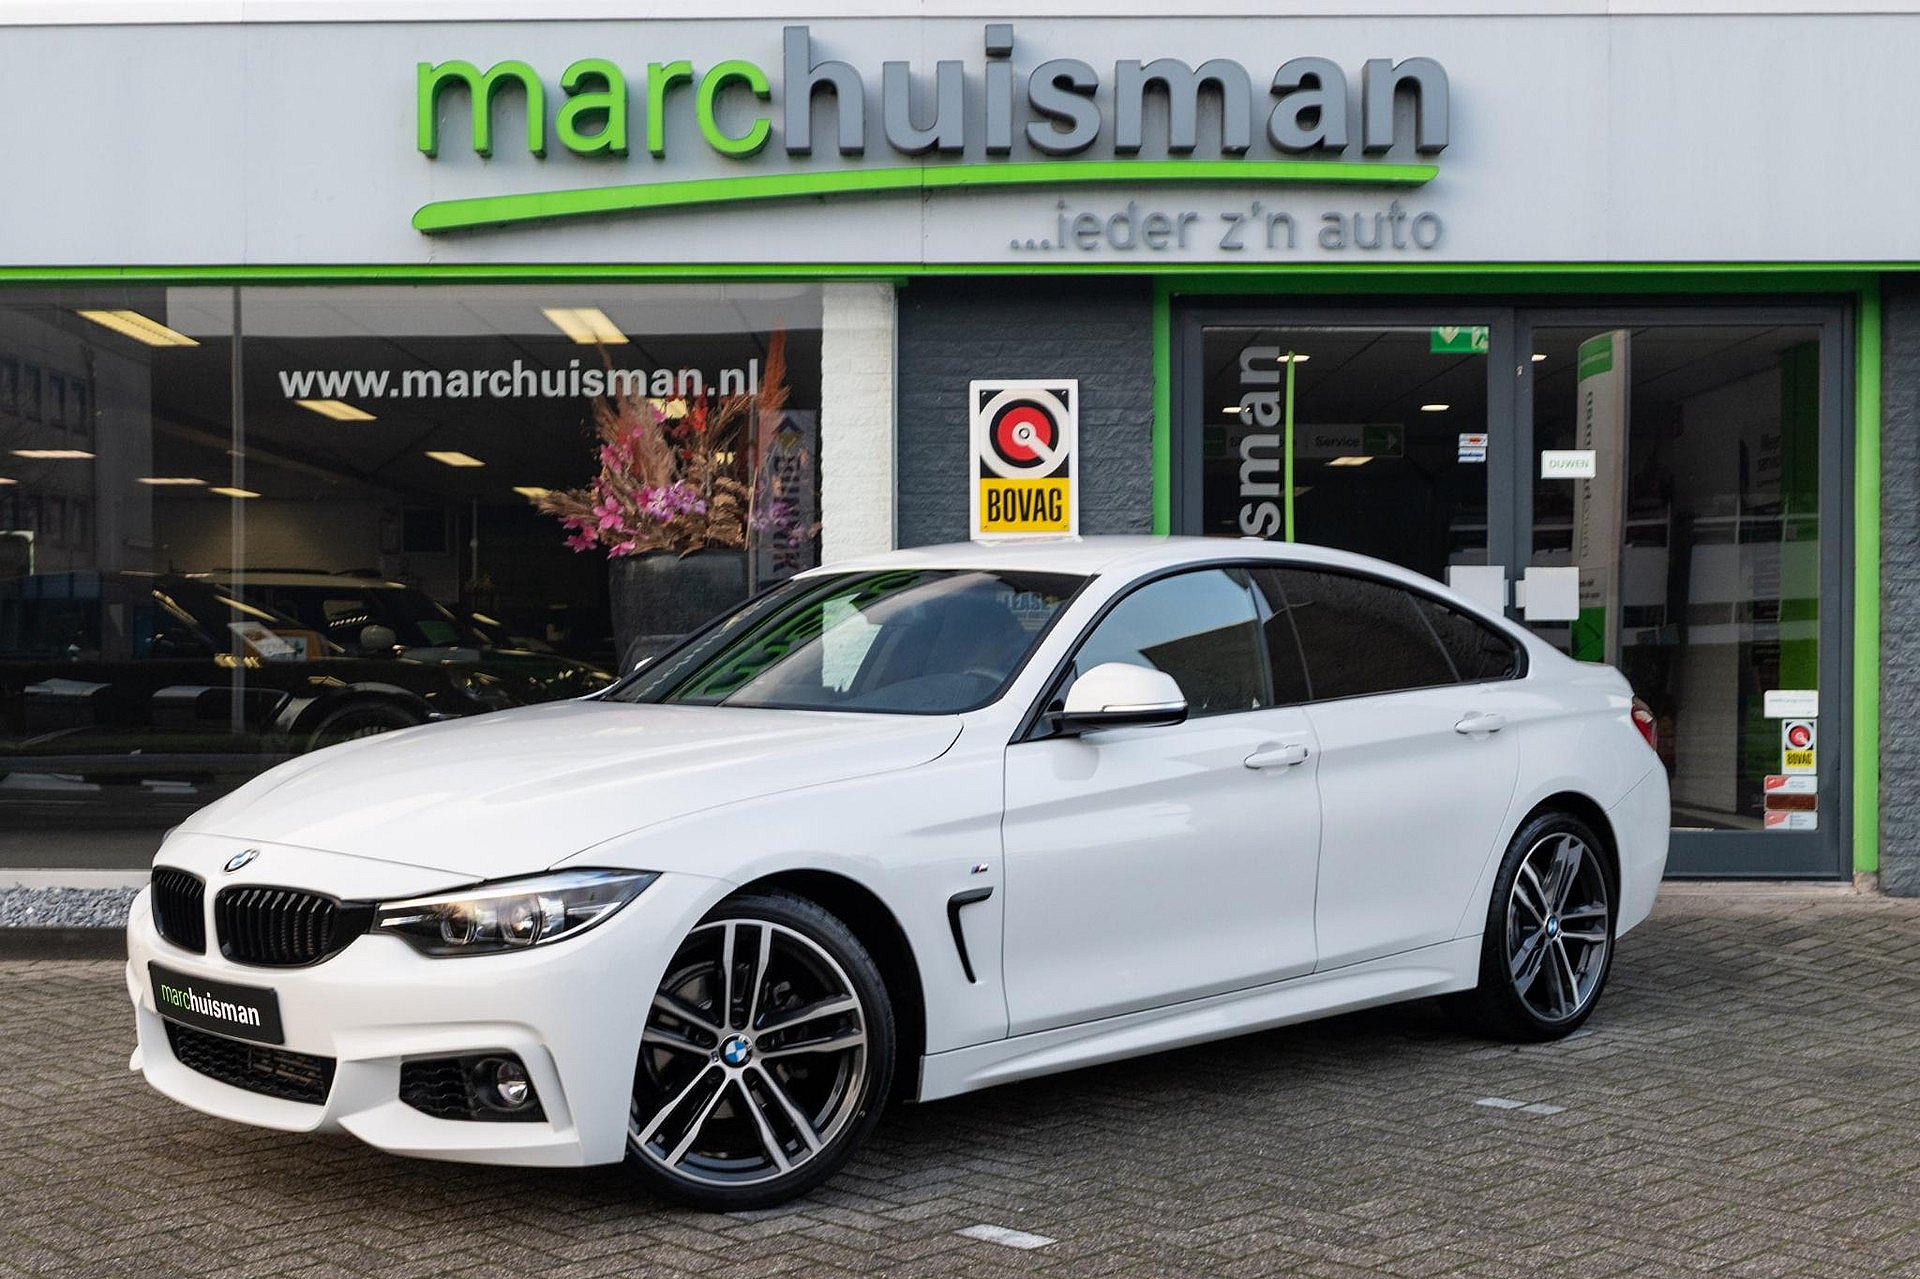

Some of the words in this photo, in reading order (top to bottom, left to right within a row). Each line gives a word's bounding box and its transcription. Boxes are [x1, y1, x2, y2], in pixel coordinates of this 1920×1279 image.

[416, 23, 1450, 158] marchuisman
[1010, 200, 1199, 251] ...ieder
[1219, 201, 1295, 250] z'n
[1317, 200, 1444, 251] auto
[279, 358, 760, 399] www.marchuisman.nl
[987, 488, 1063, 522] BOVAG
[160, 984, 261, 1027] marchuisman
